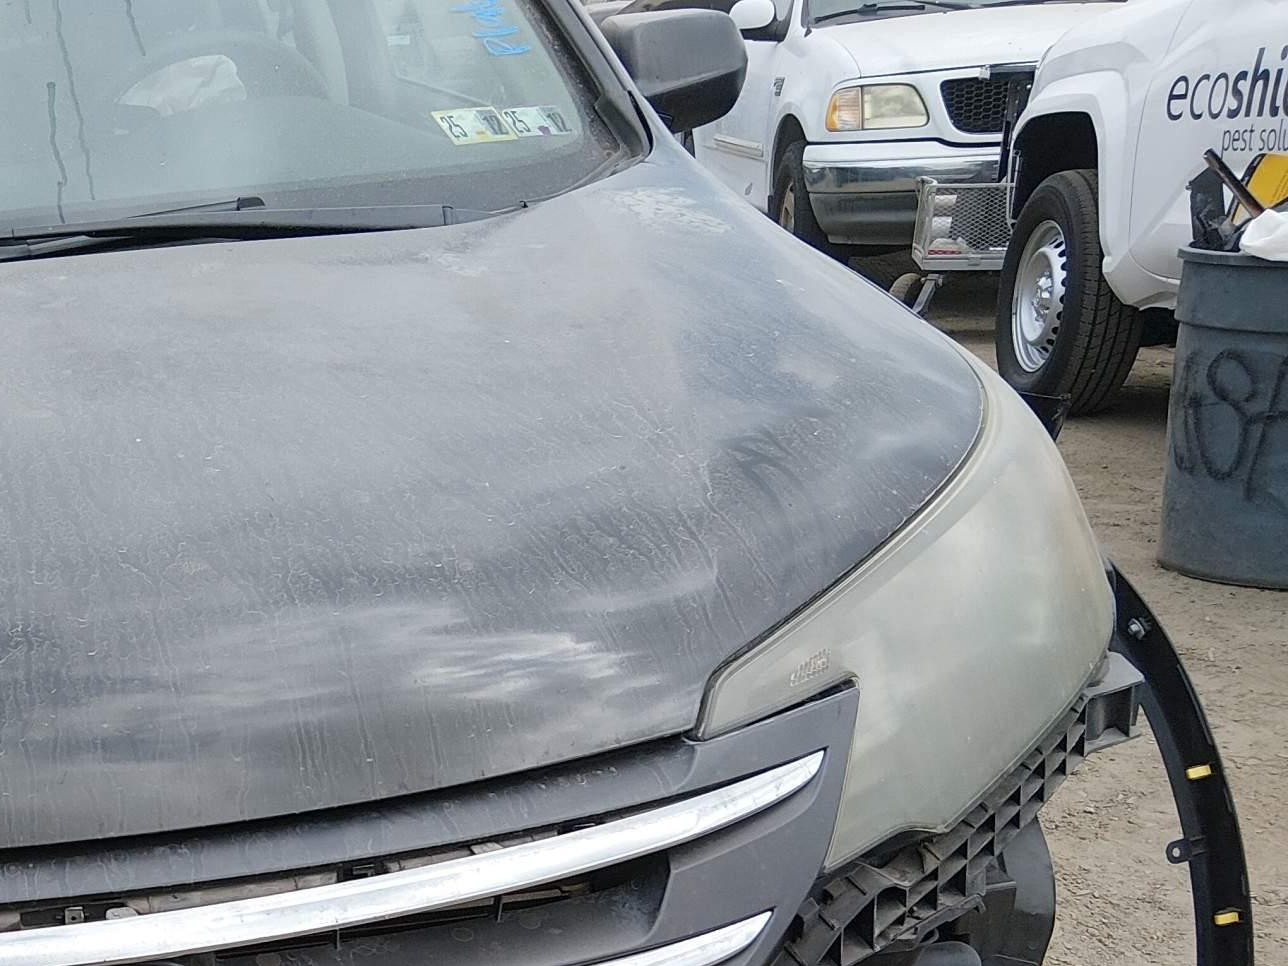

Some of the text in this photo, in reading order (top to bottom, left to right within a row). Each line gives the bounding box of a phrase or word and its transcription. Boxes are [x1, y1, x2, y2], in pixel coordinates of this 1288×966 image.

[1166, 45, 1288, 121] ecoshi
[440, 114, 510, 139] 25 12
[503, 110, 572, 133] 25 12
[1221, 124, 1255, 160] pest
